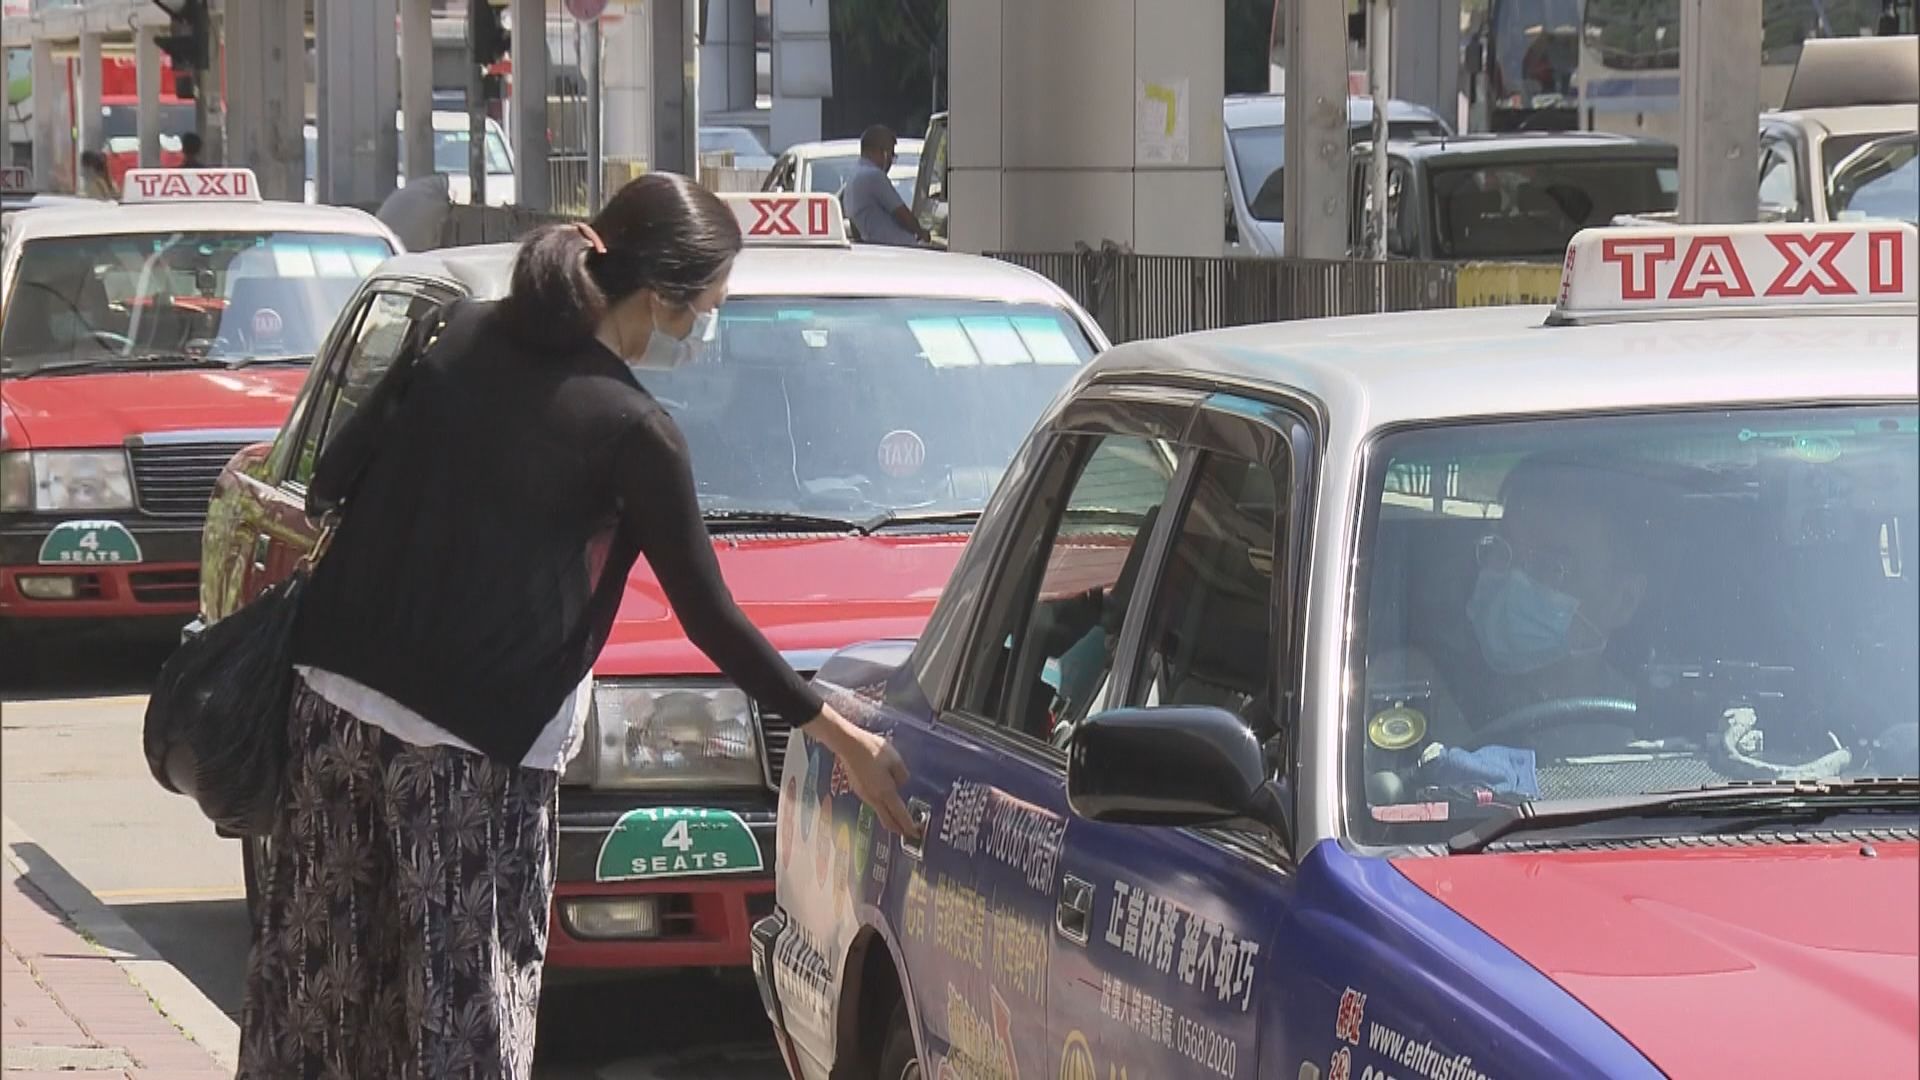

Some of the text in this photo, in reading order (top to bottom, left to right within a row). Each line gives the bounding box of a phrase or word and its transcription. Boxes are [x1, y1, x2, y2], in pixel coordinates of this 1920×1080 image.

[134, 173, 248, 196] TAXI
[748, 198, 829, 236] XI
[1602, 231, 1904, 299] TAXI
[882, 441, 922, 465] TAXI
[80, 531, 100, 551] 4
[60, 550, 120, 561] SEATS
[662, 820, 693, 851] 4
[631, 852, 728, 873] SEATS
[1105, 879, 1259, 1012] 正當財務 絕不取巧
[1177, 1015, 1237, 1080] 0568/2020
